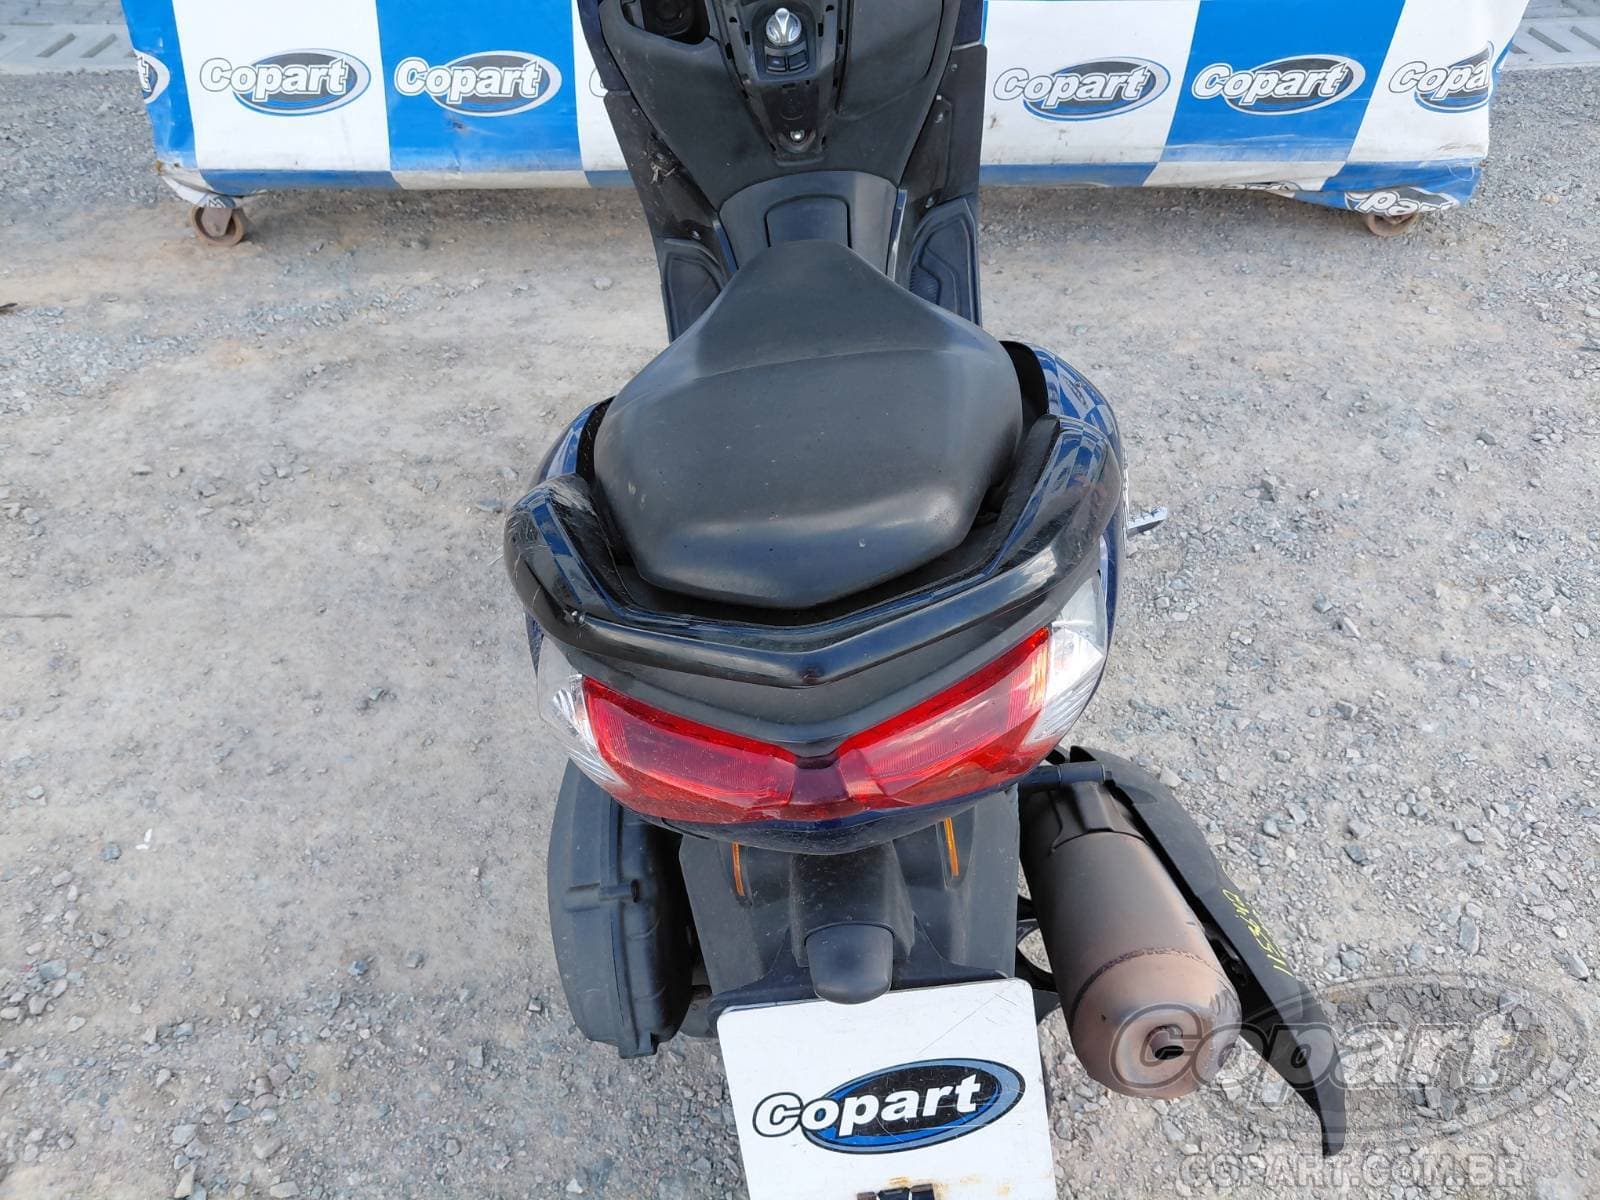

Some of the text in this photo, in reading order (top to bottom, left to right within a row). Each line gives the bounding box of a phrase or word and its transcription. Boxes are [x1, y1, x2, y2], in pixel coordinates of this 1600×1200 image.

[200, 58, 349, 101] Copart
[396, 57, 542, 104] Copart
[993, 65, 1153, 109] Copart
[1193, 61, 1352, 104] Copart
[1388, 60, 1489, 100] Copa
[752, 1073, 982, 1138] Copart
